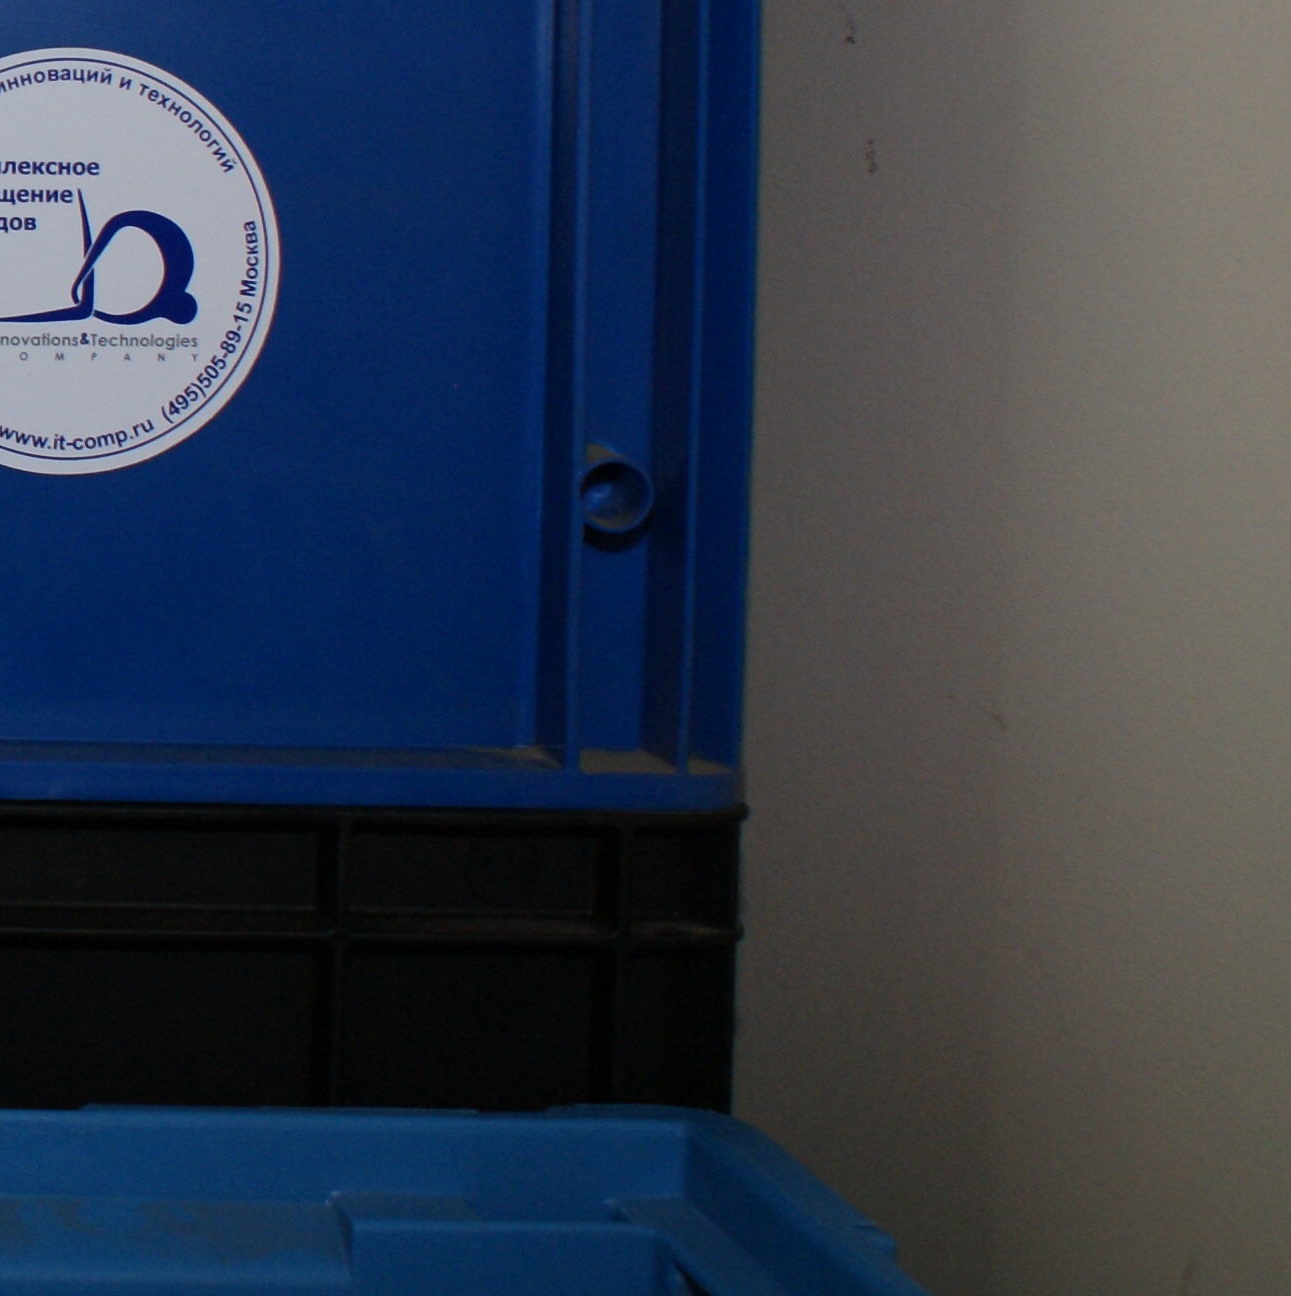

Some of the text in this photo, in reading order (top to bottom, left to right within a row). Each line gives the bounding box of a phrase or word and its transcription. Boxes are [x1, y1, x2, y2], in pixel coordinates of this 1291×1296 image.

[119, 76, 133, 91] и
[139, 83, 237, 173] технологий
[0, 419, 156, 452] www.it-comp.ru
[161, 301, 253, 424] (495)505-89-15
[239, 220, 260, 297] Москва
